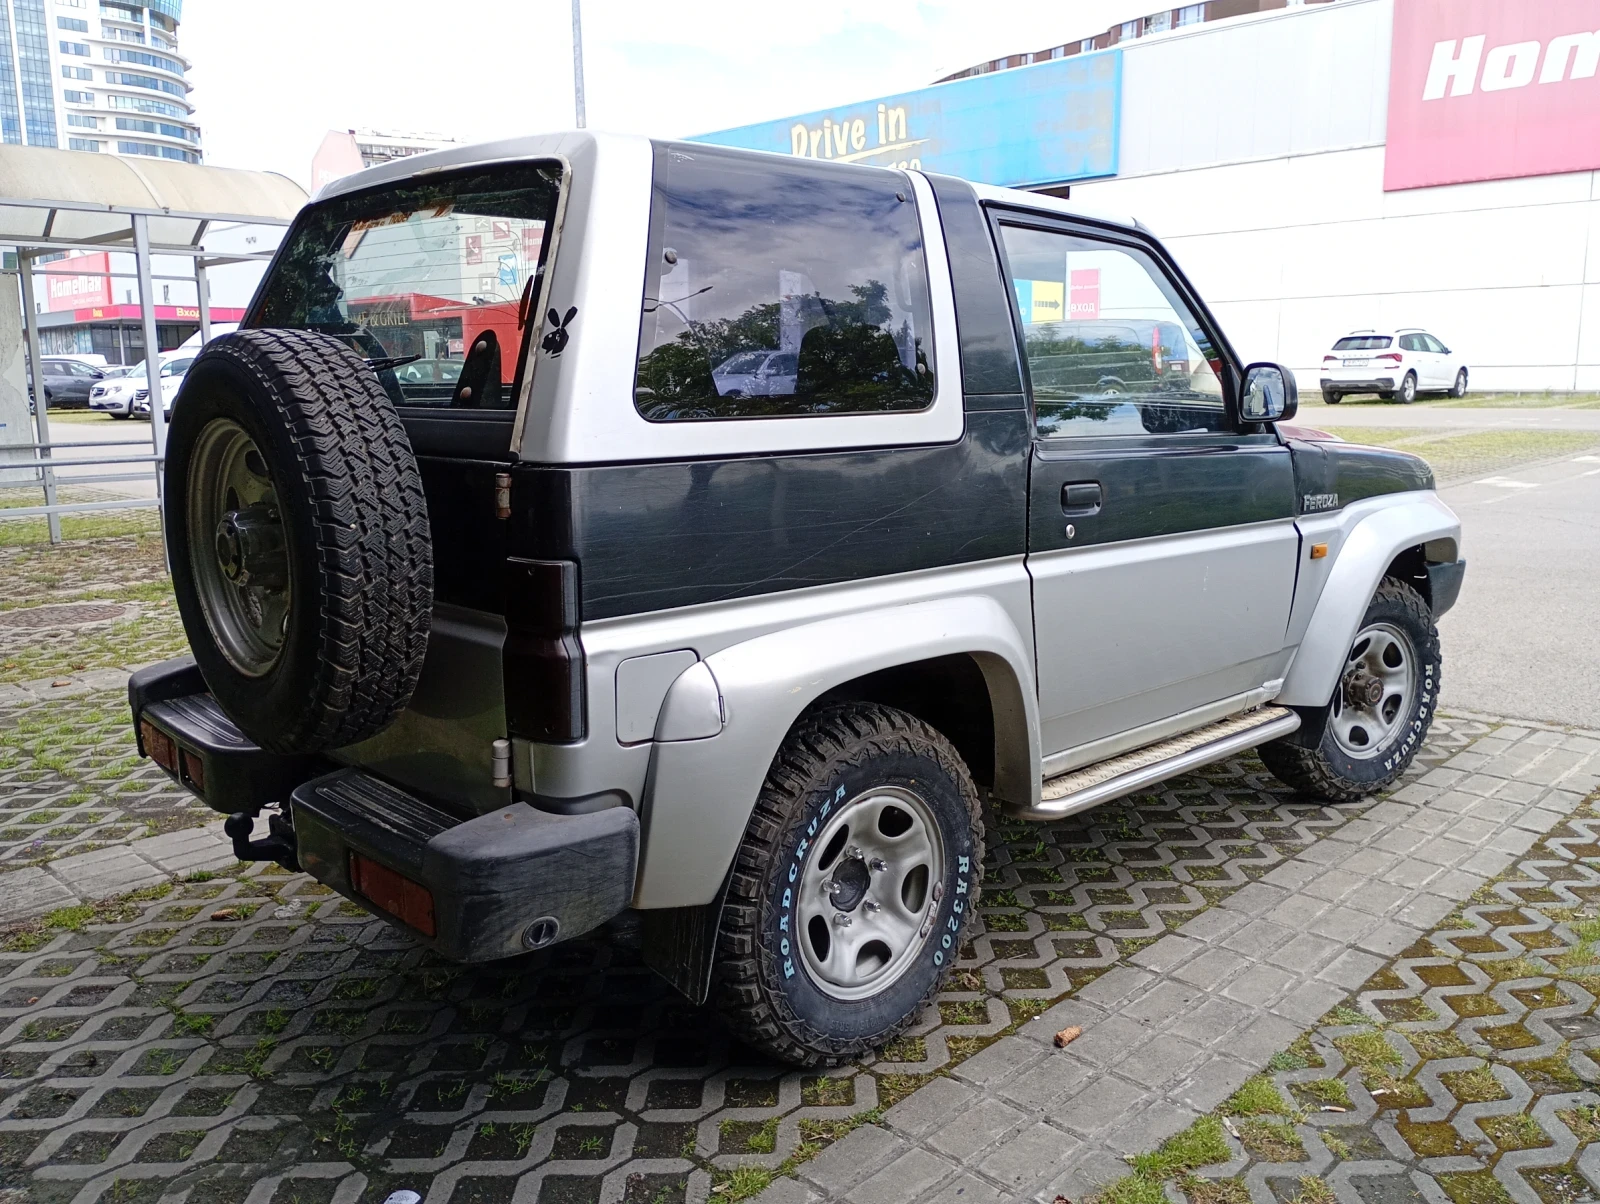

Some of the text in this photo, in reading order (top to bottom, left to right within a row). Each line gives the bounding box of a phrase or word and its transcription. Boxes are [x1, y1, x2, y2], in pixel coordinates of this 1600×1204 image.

[791, 104, 907, 158] Drive in
[50, 275, 102, 299] HomeMax
[1070, 302, 1095, 314] ВХОД
[1303, 493, 1339, 511] FEROZA
[1383, 664, 1433, 771] ROADCRUZA
[779, 784, 846, 979] ROADCRUZA
[933, 855, 970, 966] RA3200
